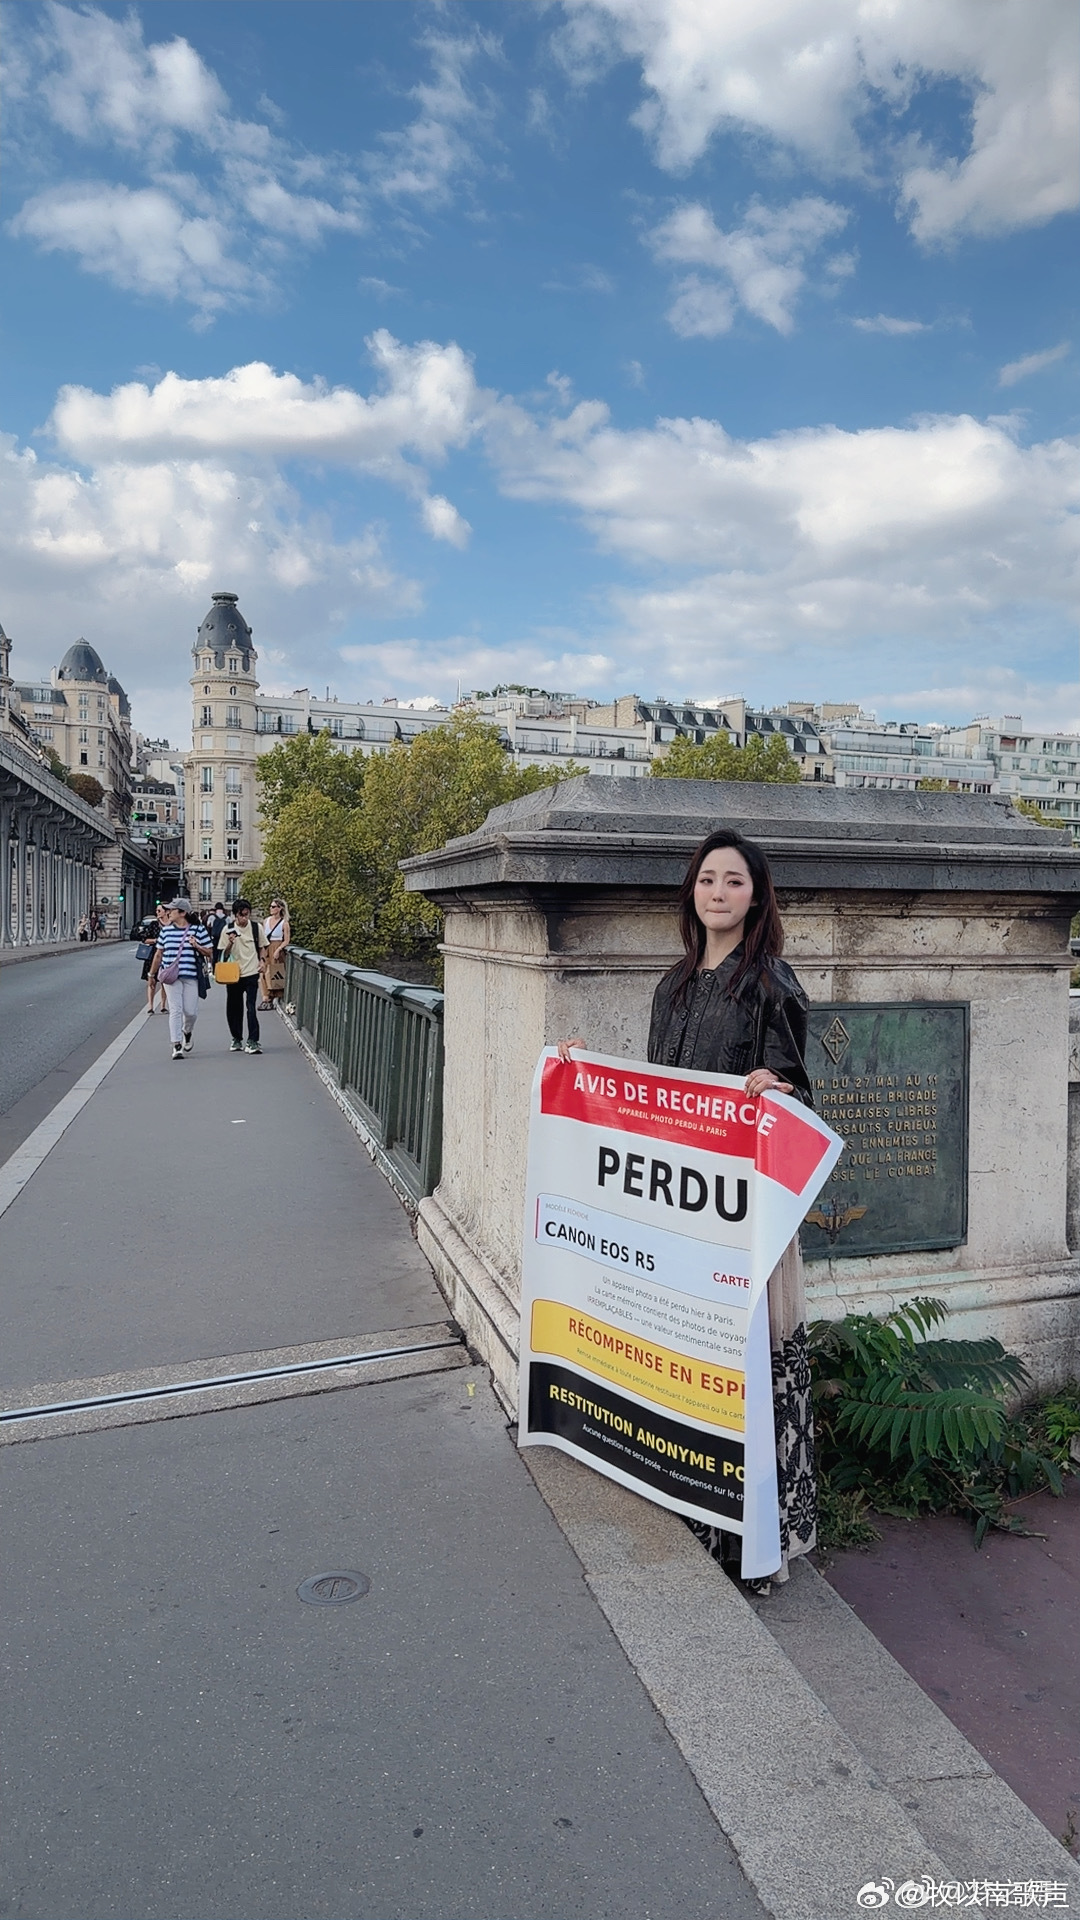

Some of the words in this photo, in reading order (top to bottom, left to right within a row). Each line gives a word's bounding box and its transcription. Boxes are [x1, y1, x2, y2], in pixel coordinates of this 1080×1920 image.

[573, 1072, 617, 1098] AVIS
[623, 1081, 649, 1105] DE
[822, 1092, 882, 1105] PREMIERE
[888, 1089, 937, 1102] BRIGADE
[831, 1077, 849, 1089] DU
[855, 1077, 870, 1088] 27
[876, 1075, 898, 1087] MAI
[906, 1075, 921, 1086] AU
[617, 1106, 649, 1120] APPAREIL
[650, 1114, 673, 1125] PHOTO
[674, 1118, 698, 1131] PERDU
[705, 1125, 728, 1137] PARIS
[896, 1105, 937, 1117] LIBRES
[830, 1122, 881, 1135] SSAUTS
[888, 1119, 937, 1132] FURIEUX
[862, 1135, 918, 1149] ENNEMIES
[924, 1134, 937, 1146] ET
[878, 1152, 891, 1164] LA
[897, 1149, 937, 1162] FRANCE
[597, 1145, 748, 1222] PERDU
[831, 1170, 855, 1181] SSE
[888, 1164, 937, 1177] COMBAT
[545, 1221, 595, 1251] CANON
[600, 1238, 629, 1263] EOS
[635, 1250, 655, 1272] R5
[712, 1271, 750, 1289] CARTE
[602, 1290, 616, 1301] carte
[617, 1296, 642, 1311] mémoire
[643, 1305, 668, 1320] contient
[669, 1314, 680, 1325] des
[681, 1318, 706, 1333] photos
[707, 1327, 718, 1337] de
[611, 1279, 635, 1294] appareil
[635, 1288, 653, 1301] photo
[659, 1296, 670, 1307] été
[671, 1301, 689, 1314] perdu
[690, 1307, 705, 1319] hier
[706, 1312, 712, 1321] à
[714, 1313, 736, 1326] Paris.
[568, 1317, 663, 1374] RÉCOMPENSE
[669, 1363, 693, 1385] EN
[640, 1319, 652, 1329] une
[653, 1322, 673, 1336] valeur
[674, 1331, 722, 1352] sentimentale
[723, 1346, 743, 1357] sans
[711, 1405, 720, 1414] ou
[549, 1384, 633, 1438] RESTITUTION
[636, 1427, 716, 1473] ANONYME
[669, 1469, 713, 1491] récompense
[713, 1485, 726, 1496] sur
[727, 1488, 735, 1499] le
